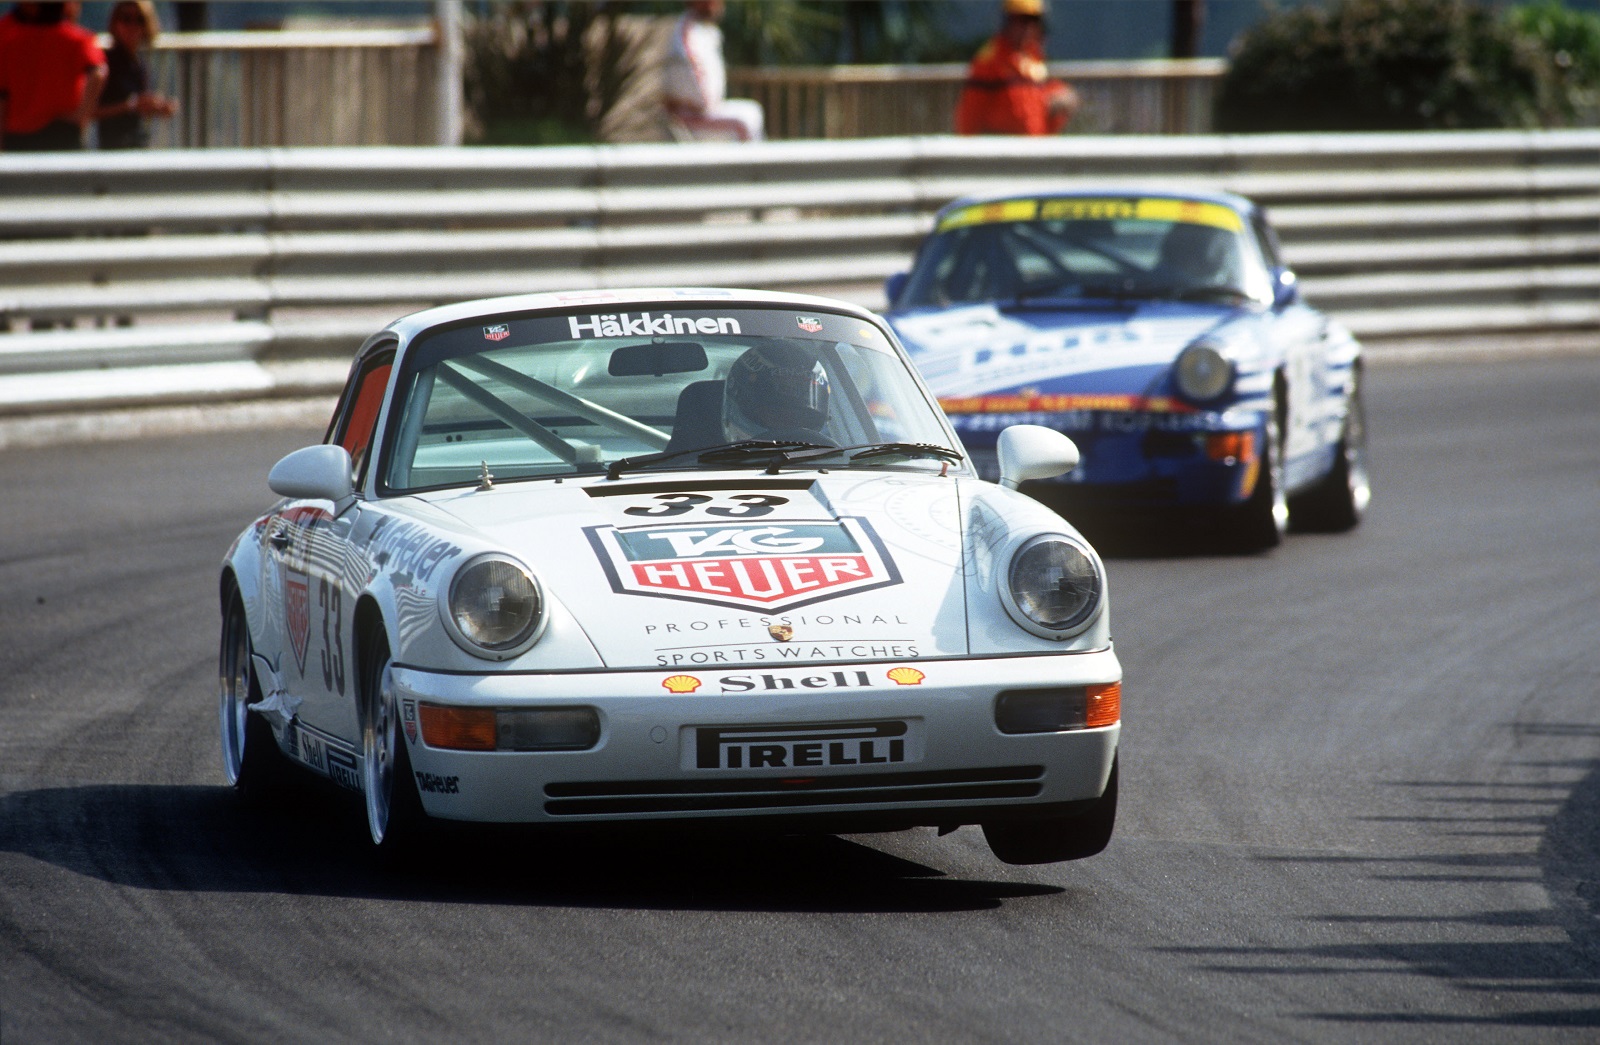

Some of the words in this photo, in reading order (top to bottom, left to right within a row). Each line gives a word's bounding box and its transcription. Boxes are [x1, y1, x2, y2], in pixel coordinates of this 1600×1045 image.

[568, 312, 741, 338] Häkkinen
[623, 493, 790, 517] 33
[647, 526, 824, 557] TAG
[644, 558, 867, 598] HEUER
[319, 573, 345, 697] 33
[645, 614, 908, 635] PROFESSIONAL
[656, 648, 765, 667] SPORTS
[777, 646, 920, 657] WATCHES
[719, 670, 874, 694] Shell
[302, 732, 324, 769] Shell
[696, 720, 908, 769] PIRELLI
